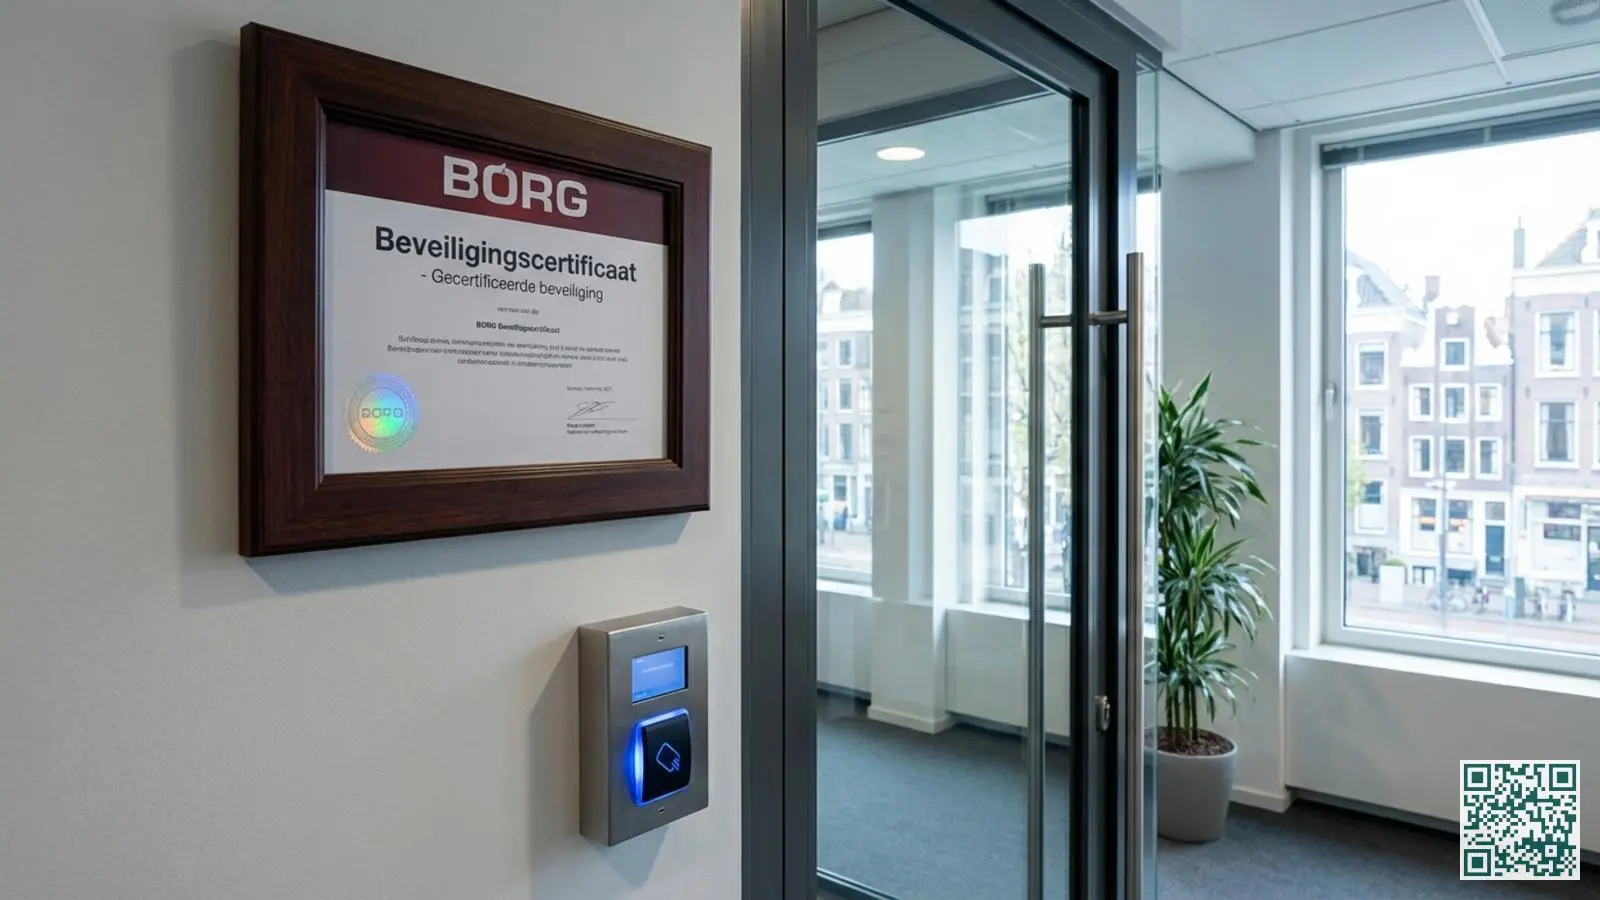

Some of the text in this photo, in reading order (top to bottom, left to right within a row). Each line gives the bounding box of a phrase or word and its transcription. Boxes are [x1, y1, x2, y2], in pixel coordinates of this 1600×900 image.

[443, 155, 588, 218] BORG
[375, 226, 637, 282] Beveiligingscertificaat
[431, 268, 536, 293] Gecertificeerde
[539, 280, 604, 303] beveiliging
